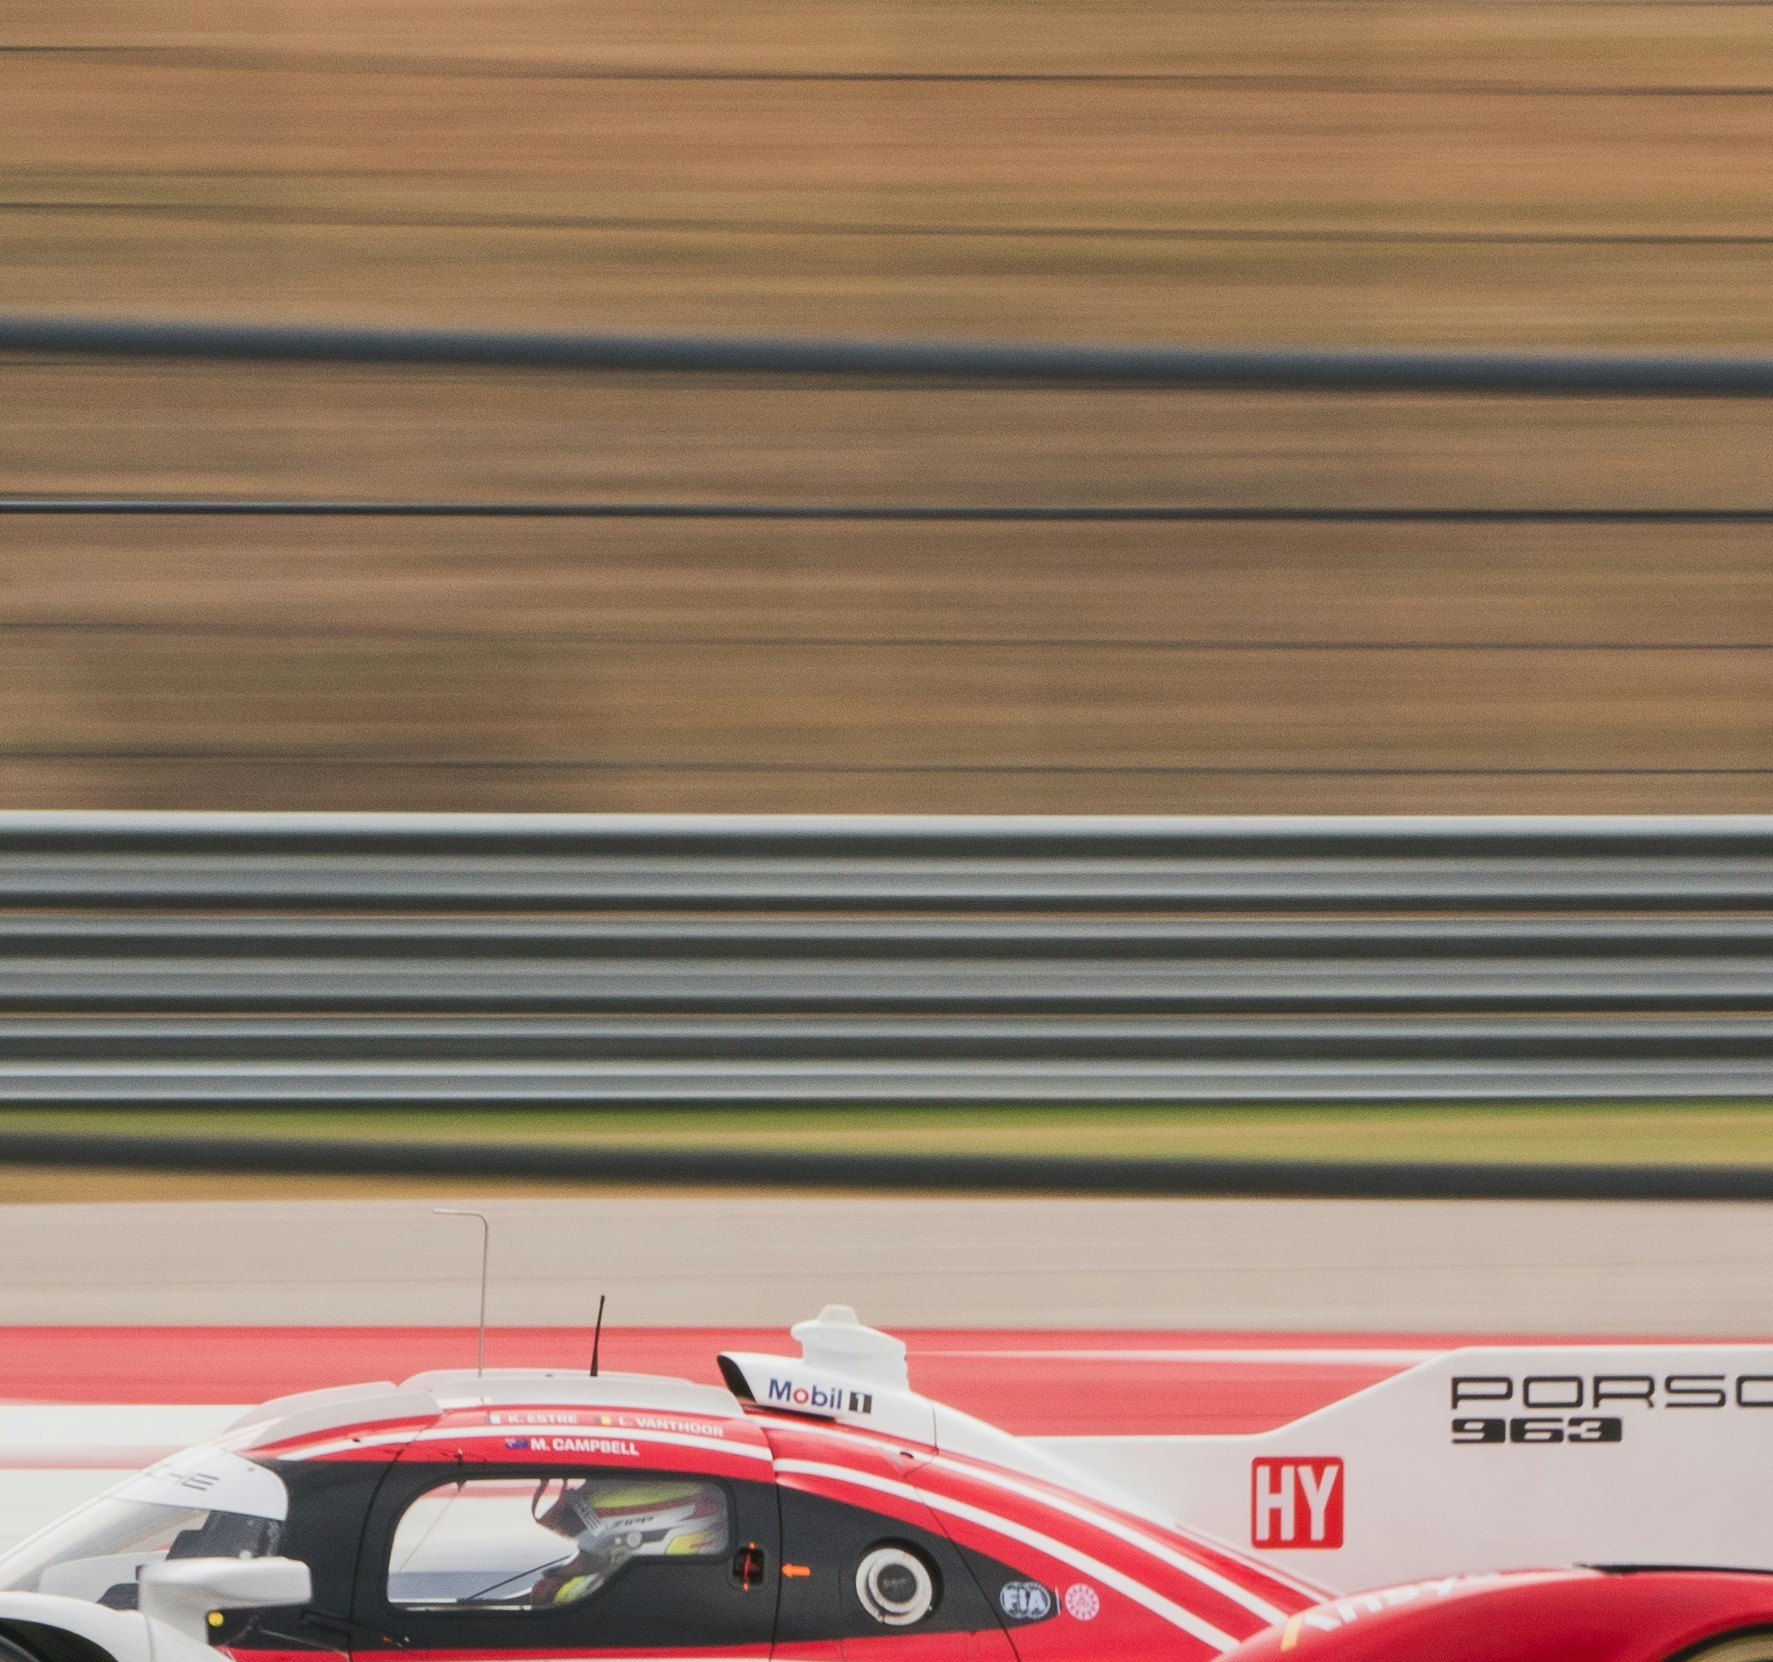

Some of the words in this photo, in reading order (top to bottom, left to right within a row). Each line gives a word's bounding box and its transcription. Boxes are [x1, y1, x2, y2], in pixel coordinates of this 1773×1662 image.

[768, 1377, 843, 1410] Mobil
[636, 1417, 724, 1437] VANTHOOR
[1450, 1416, 1623, 1443] 963
[530, 1438, 550, 1451] M.
[552, 1438, 640, 1456] CAMPBELL
[1254, 1465, 1339, 1541] HY
[1003, 1588, 1047, 1611] FIA
